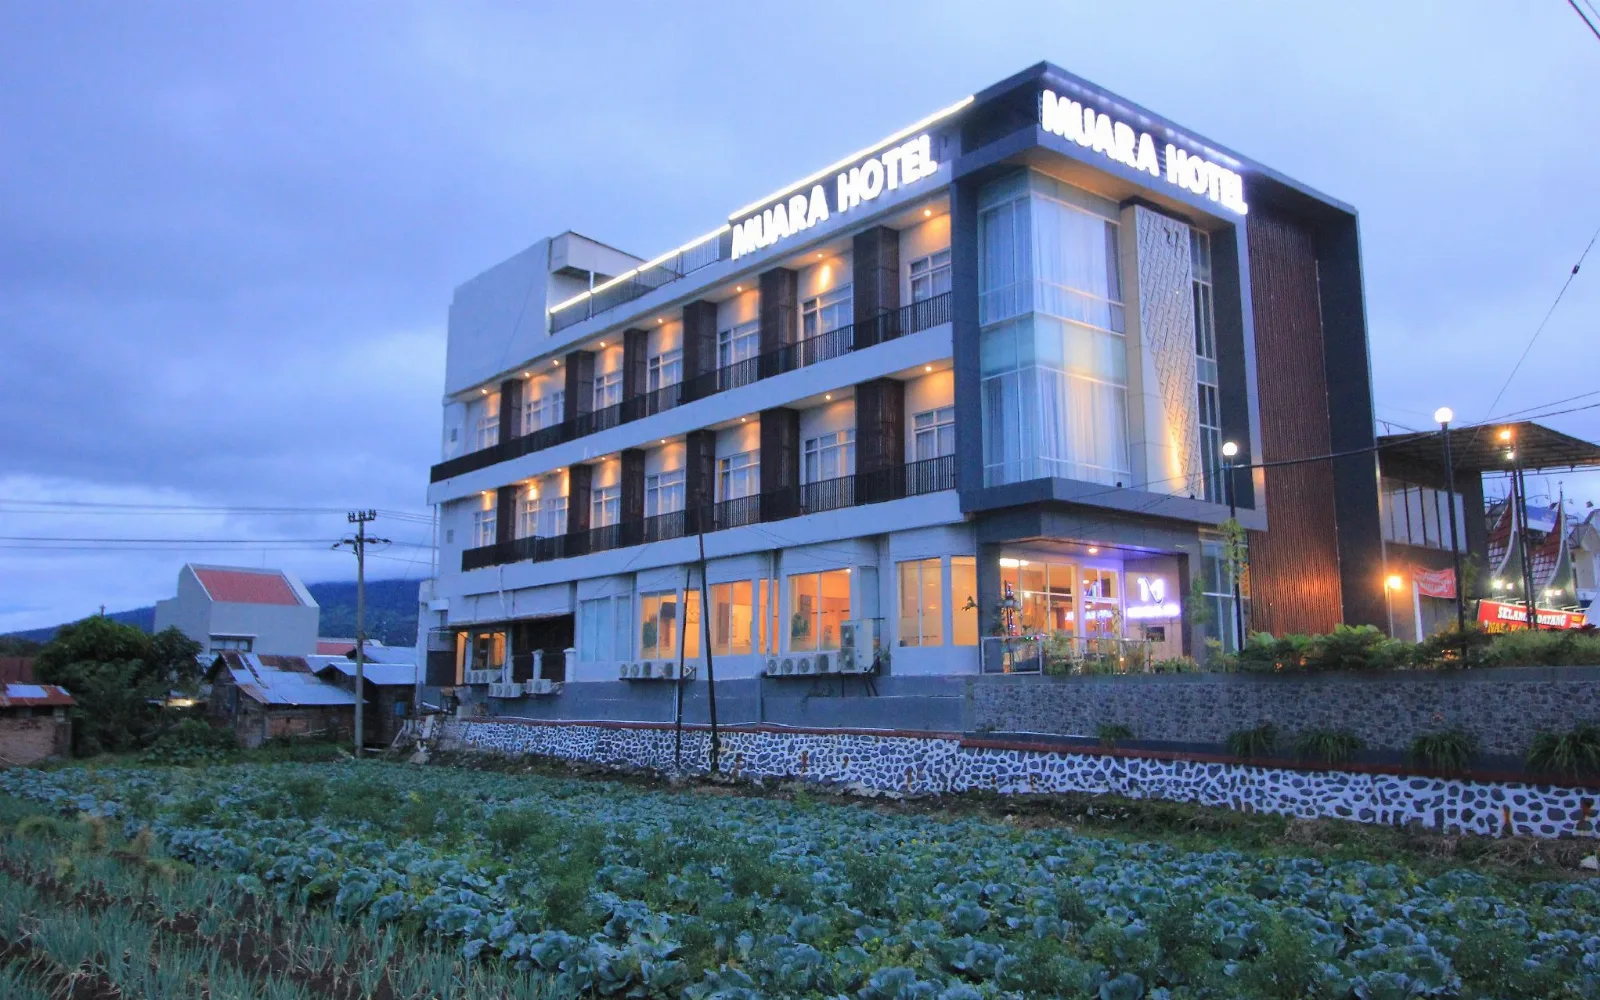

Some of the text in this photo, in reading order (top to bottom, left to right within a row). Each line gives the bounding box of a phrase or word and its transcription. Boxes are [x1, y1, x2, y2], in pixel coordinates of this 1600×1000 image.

[731, 134, 937, 261] MUARA HOTEL
[1041, 89, 1248, 215] MUARA HOTEL
[1498, 606, 1534, 623] SELAM
